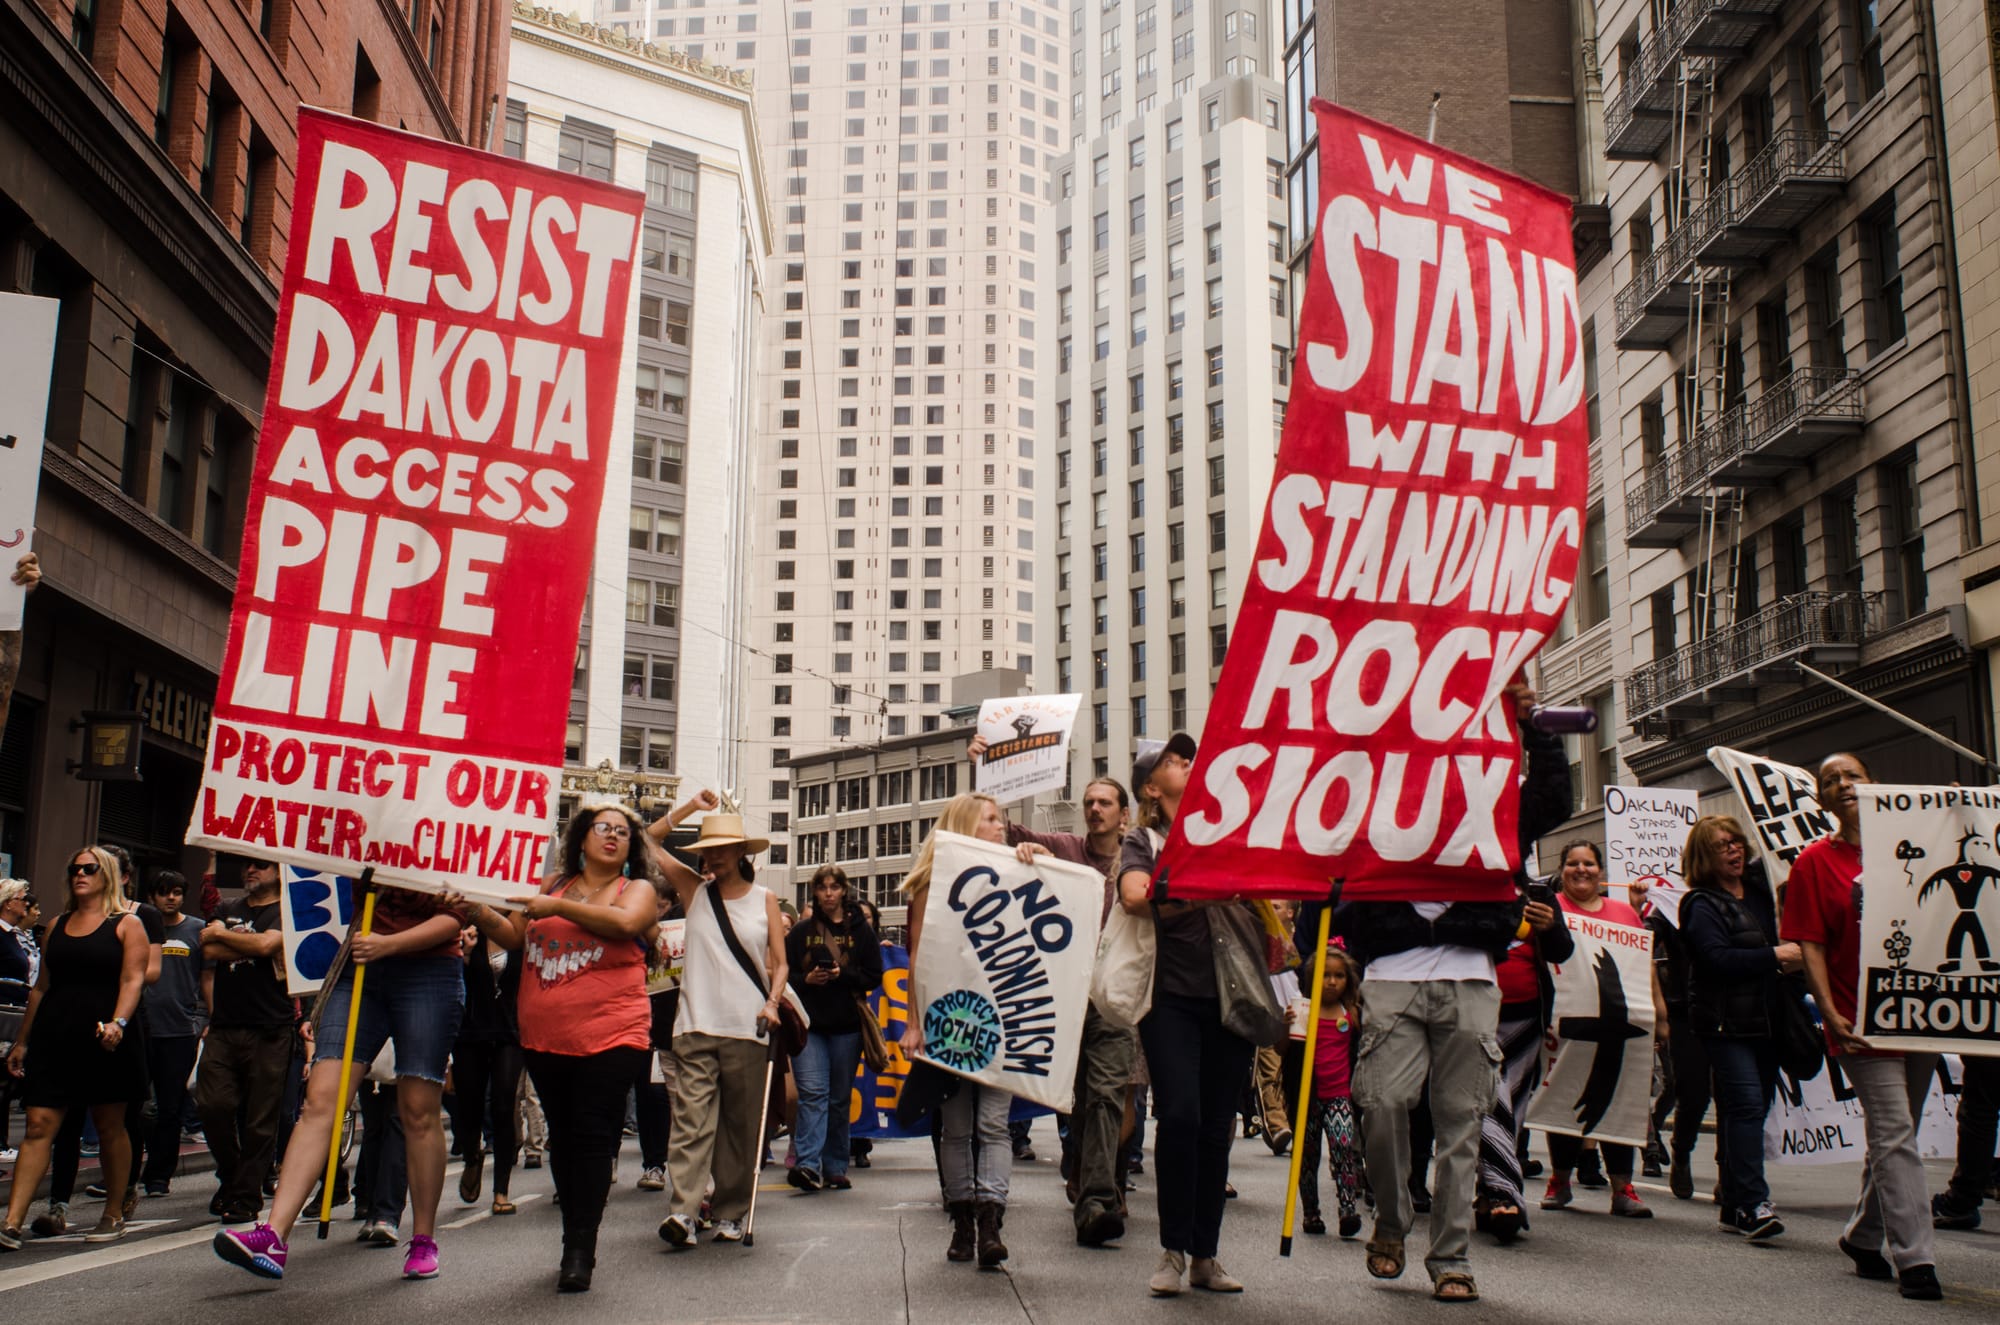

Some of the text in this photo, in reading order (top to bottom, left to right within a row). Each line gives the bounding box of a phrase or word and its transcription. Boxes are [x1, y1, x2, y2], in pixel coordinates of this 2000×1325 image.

[1358, 133, 1511, 235] WE
[304, 139, 636, 338] RESIST
[1306, 194, 1584, 425] STAND
[279, 292, 589, 461] DAKOTA
[269, 427, 575, 528] ACCESS
[1345, 411, 1557, 490] WITH
[254, 496, 507, 637] PIPE
[1257, 473, 1580, 617] STANDING
[135, 671, 209, 749] 7-ELEVE
[229, 611, 477, 740] LINE
[1241, 609, 1544, 743] ROCK
[211, 724, 551, 820] PROTECT OUR
[989, 734, 1057, 759] RESISTANCE
[202, 788, 549, 886] WATER AND CLIMATE
[1183, 742, 1513, 871] SIOUX
[1606, 787, 1698, 826] OAKLAND
[1629, 817, 1677, 830] STANDS
[1635, 831, 1668, 841] WITH
[1757, 809, 1834, 851] IT IN
[1875, 793, 1912, 812] NO
[1609, 840, 1686, 860] STANDIN
[1625, 861, 1686, 877] ROCK
[1022, 878, 1073, 953] NO
[1582, 919, 1604, 939] NO
[1607, 927, 1650, 952] MORE
[934, 989, 1001, 1025] PROTECT
[1874, 996, 2000, 1033] GROU
[1876, 974, 1998, 994] KEEP IT IN
[924, 1011, 1001, 1052] MOTHER
[925, 1038, 990, 1073] EARTH
